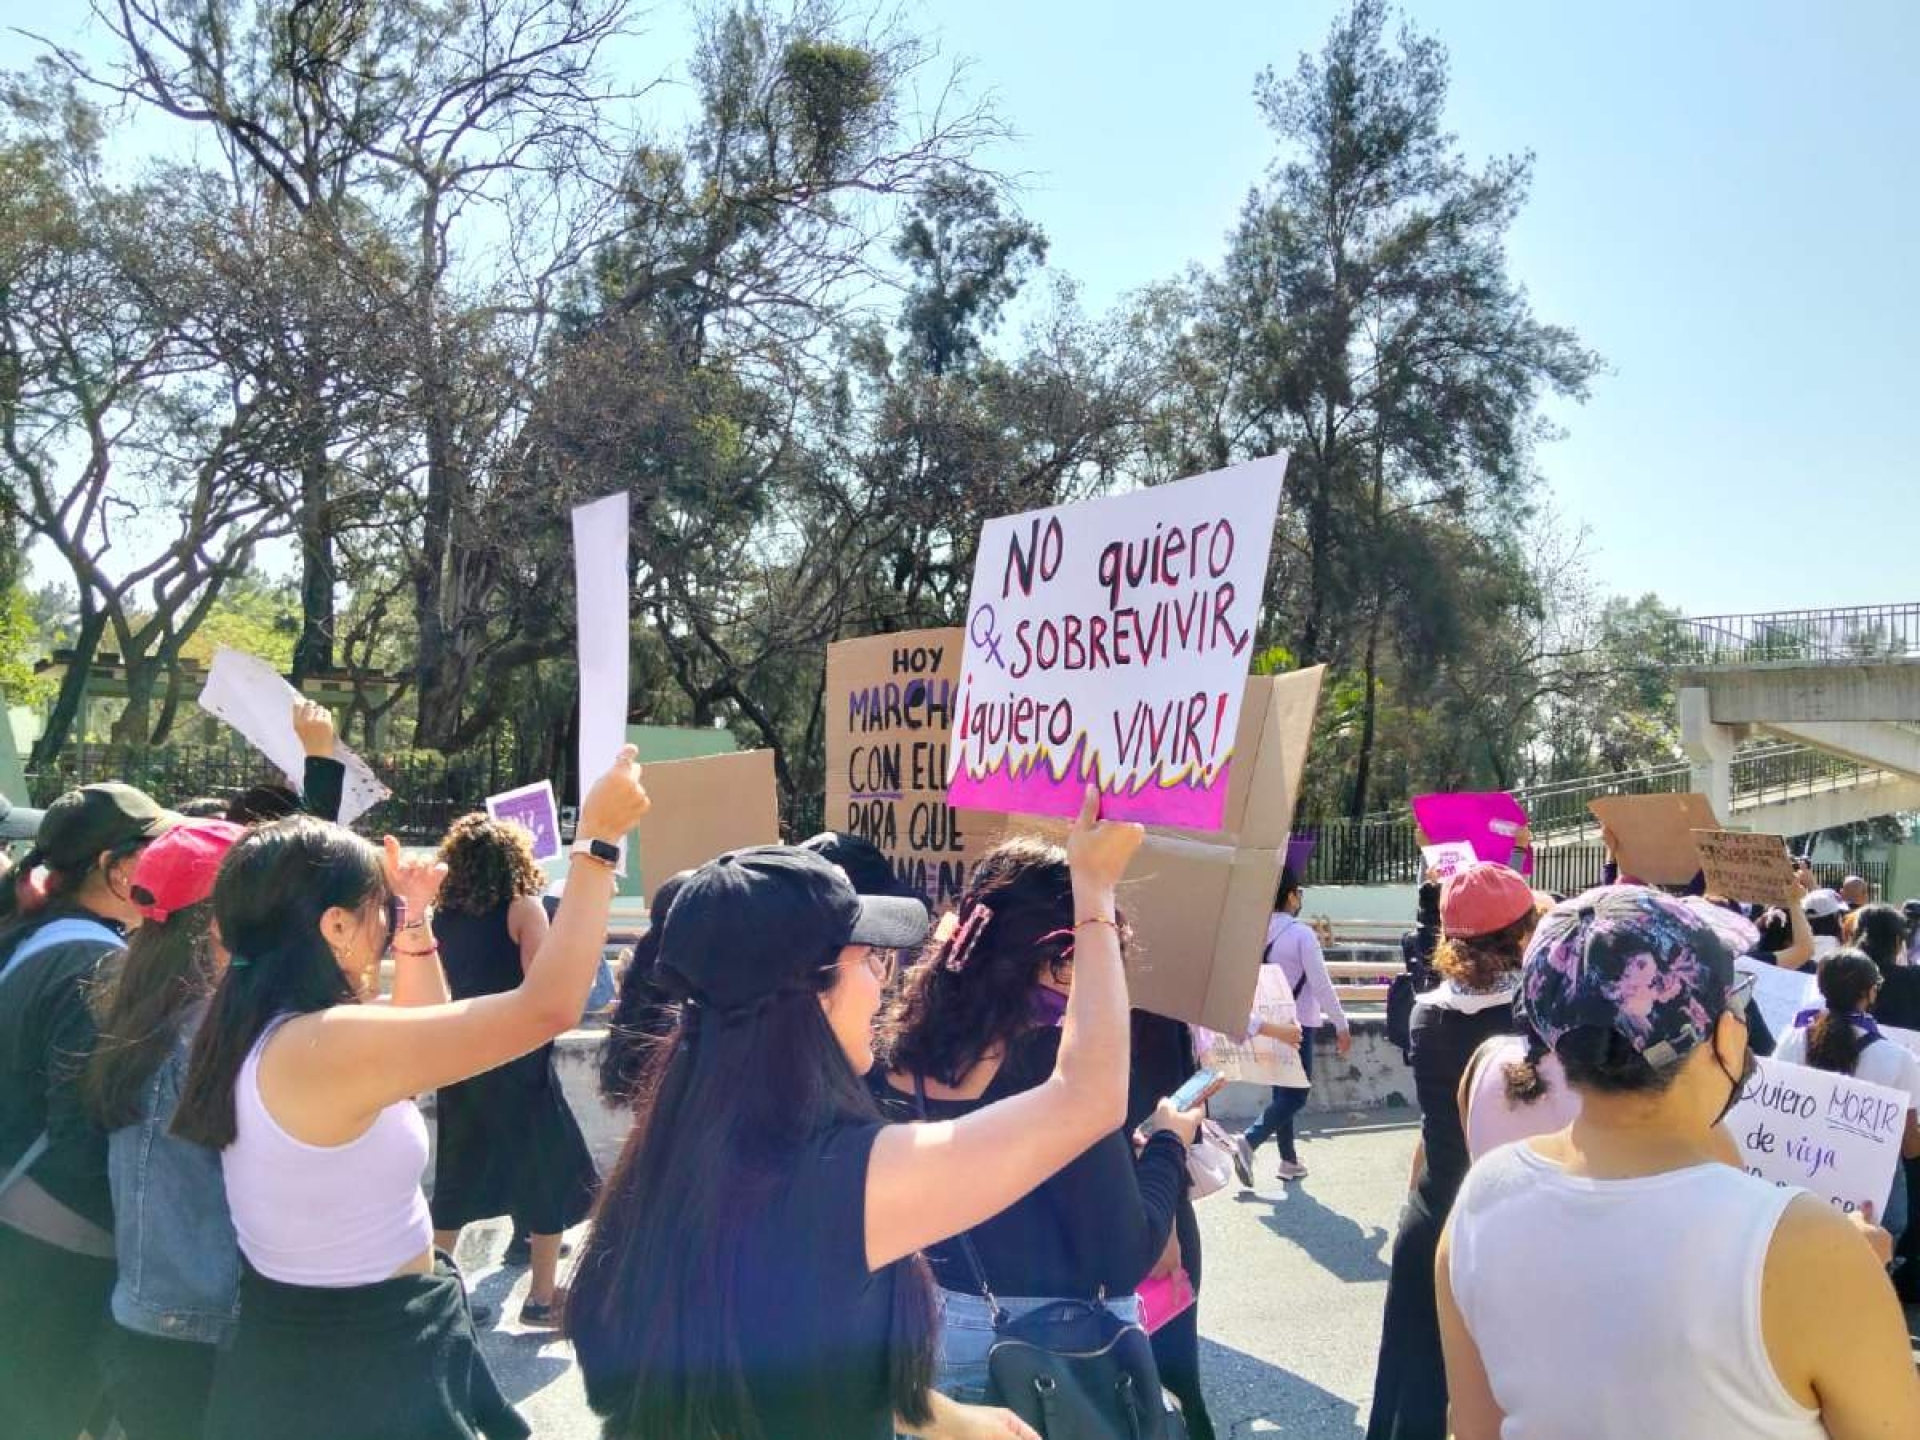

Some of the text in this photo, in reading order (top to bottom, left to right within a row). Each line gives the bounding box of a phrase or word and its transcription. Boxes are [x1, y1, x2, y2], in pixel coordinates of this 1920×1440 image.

[1002, 515, 1235, 611] NO quiero
[1010, 581, 1249, 679] SOBREVIVIR,
[892, 647, 944, 674] HOY
[849, 678, 959, 733] MARCH
[1113, 691, 1229, 775] VIVIR!
[849, 742, 900, 793] CON
[908, 800, 966, 851] QUE
[1828, 1085, 1899, 1133] MORIR
[1746, 1122, 1775, 1153] de
